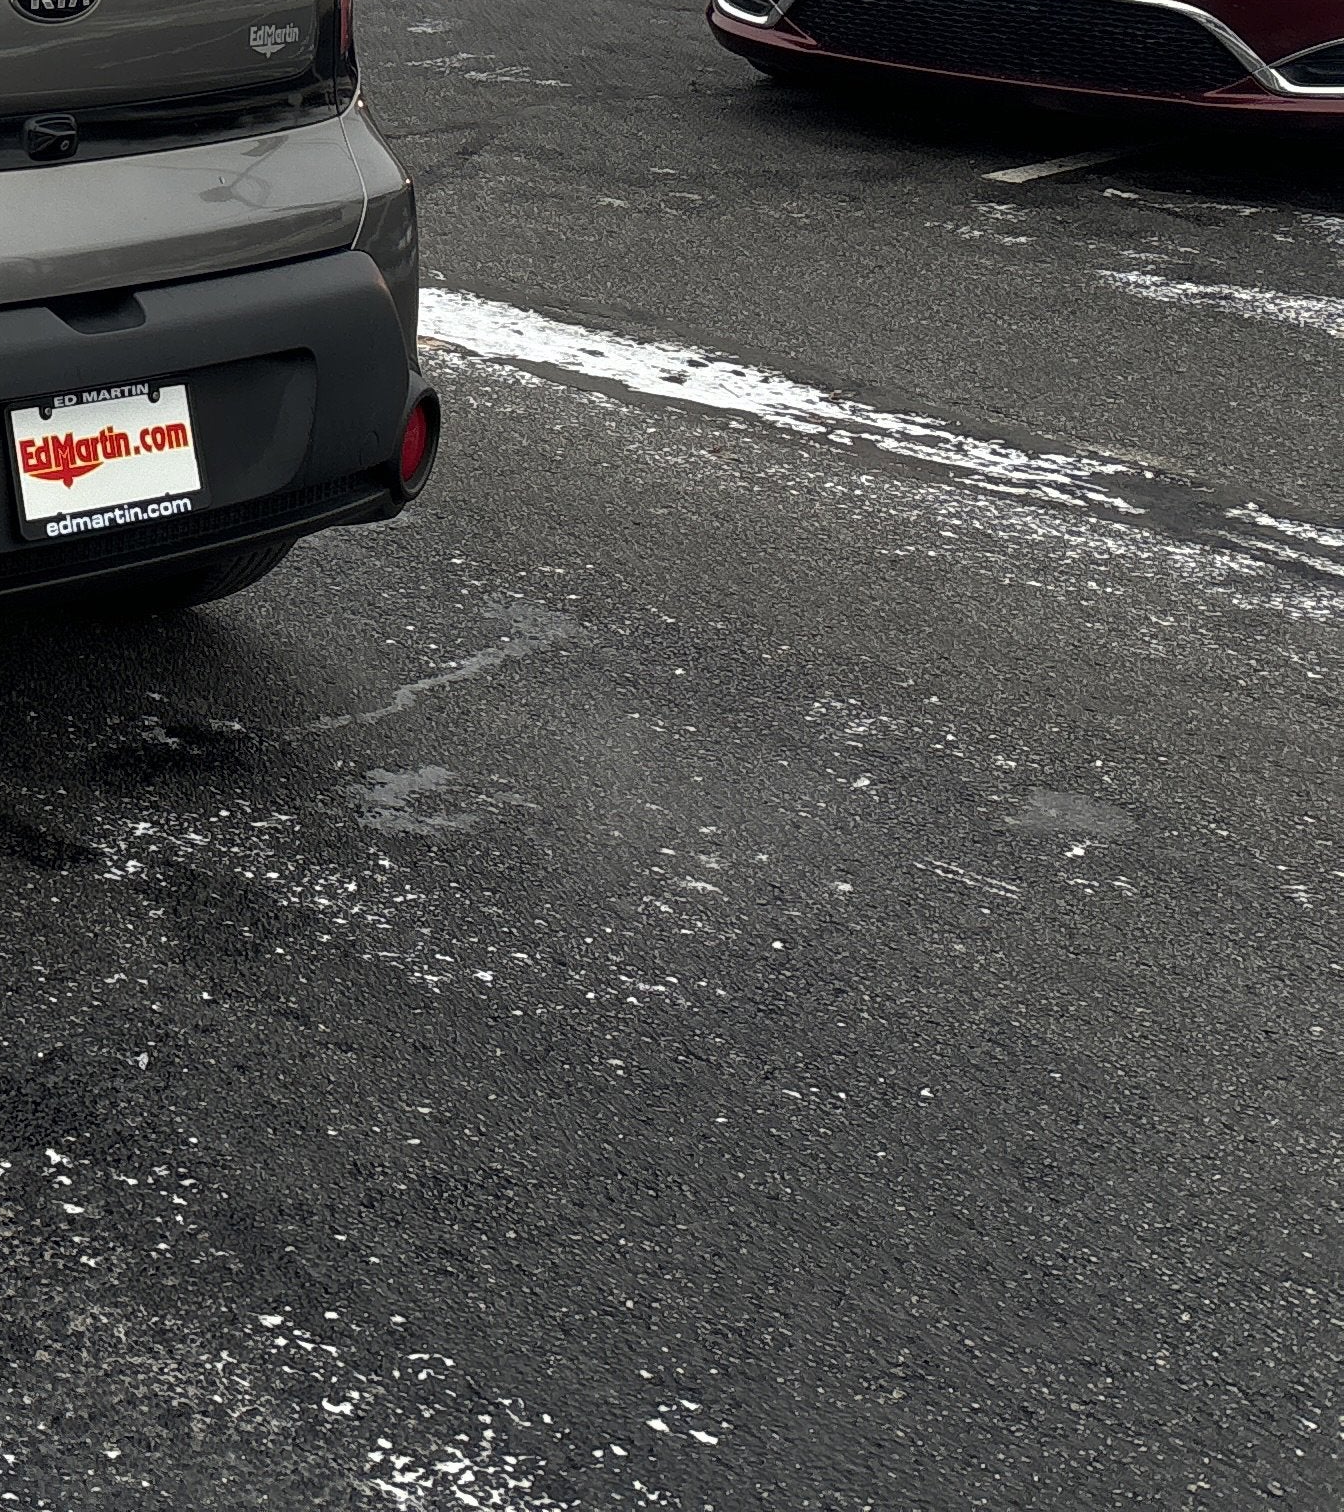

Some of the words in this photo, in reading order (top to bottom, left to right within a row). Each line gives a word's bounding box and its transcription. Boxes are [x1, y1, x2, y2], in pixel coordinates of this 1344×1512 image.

[53, 395, 77, 408] ED
[82, 382, 149, 404] MARTIN
[19, 421, 190, 474] EdMartin.com
[46, 496, 192, 537] edmartin.com
